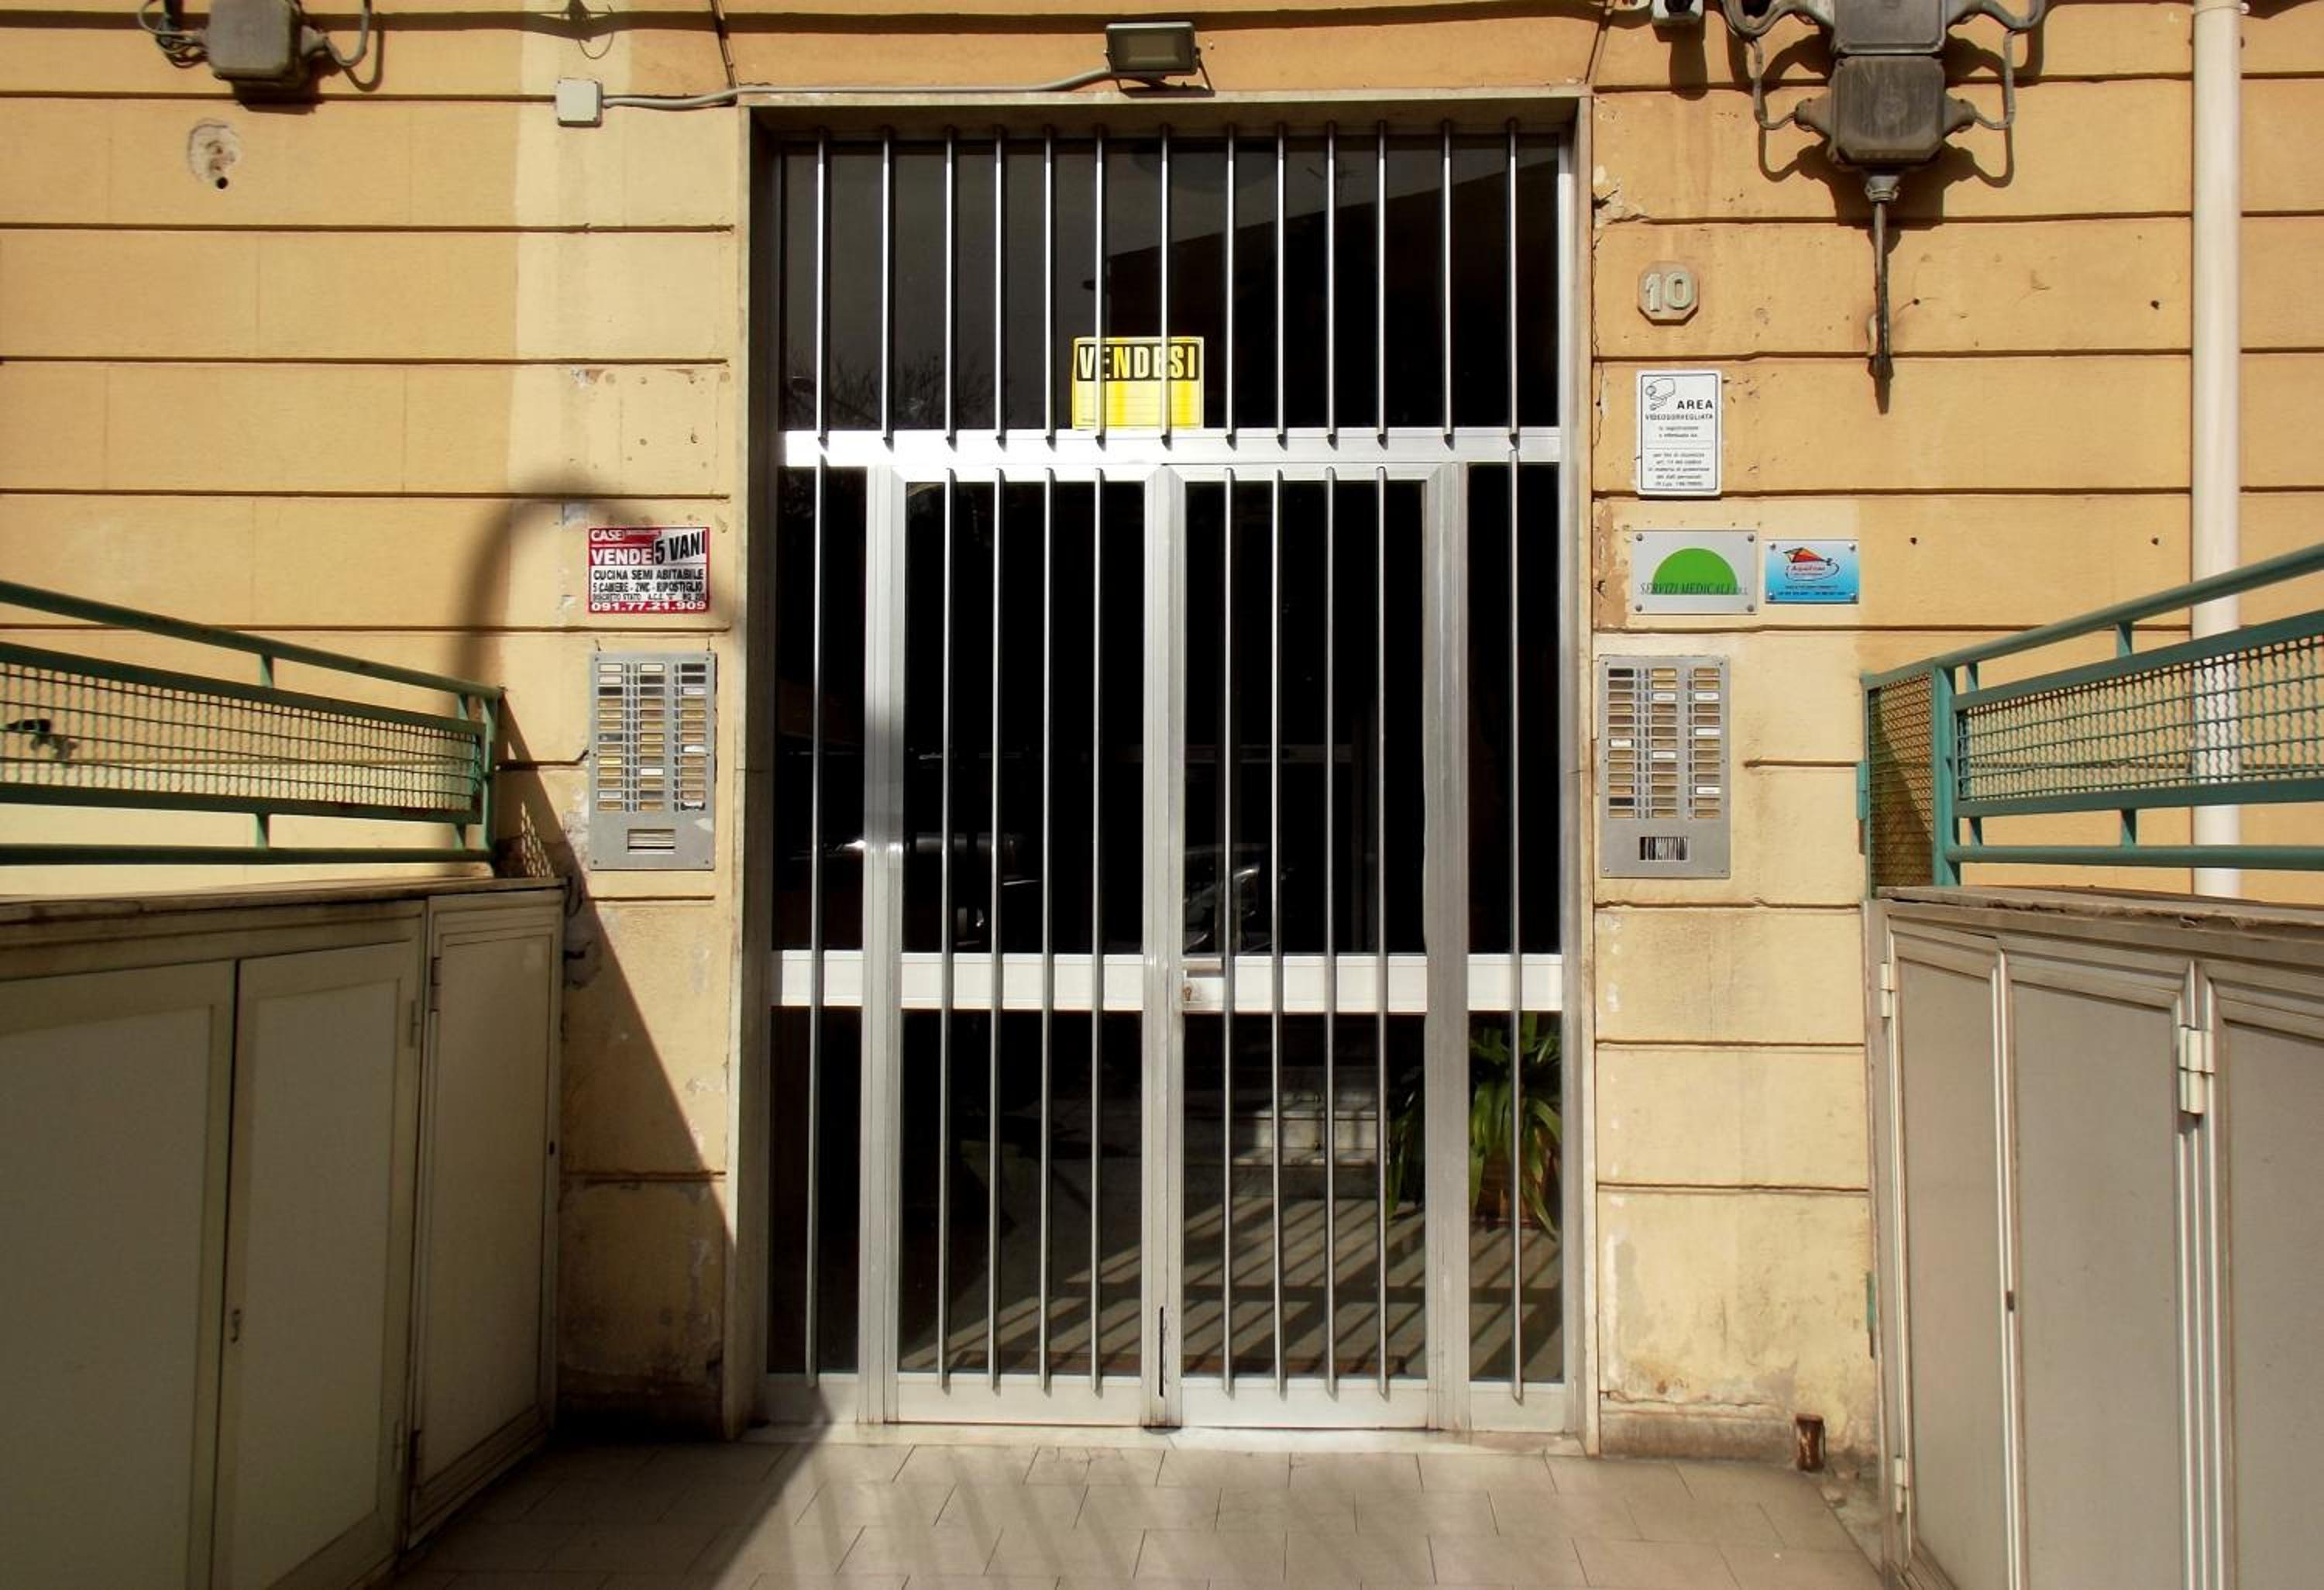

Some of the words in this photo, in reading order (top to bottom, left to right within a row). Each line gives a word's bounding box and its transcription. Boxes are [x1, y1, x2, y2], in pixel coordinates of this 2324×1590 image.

[1645, 273, 1693, 311] 10
[1079, 346, 1195, 379] VENDESI
[1677, 399, 1714, 410] AREA
[591, 530, 623, 542] CASE
[655, 539, 665, 565] 5
[669, 531, 706, 561] VANI
[591, 548, 652, 565] VENDE
[593, 570, 628, 580] CUCINA
[631, 570, 653, 580] SEMI
[656, 569, 703, 580] ABITABILE
[656, 581, 703, 592] RIPOSTIGLIO
[591, 601, 706, 611] 091.77.21.909
